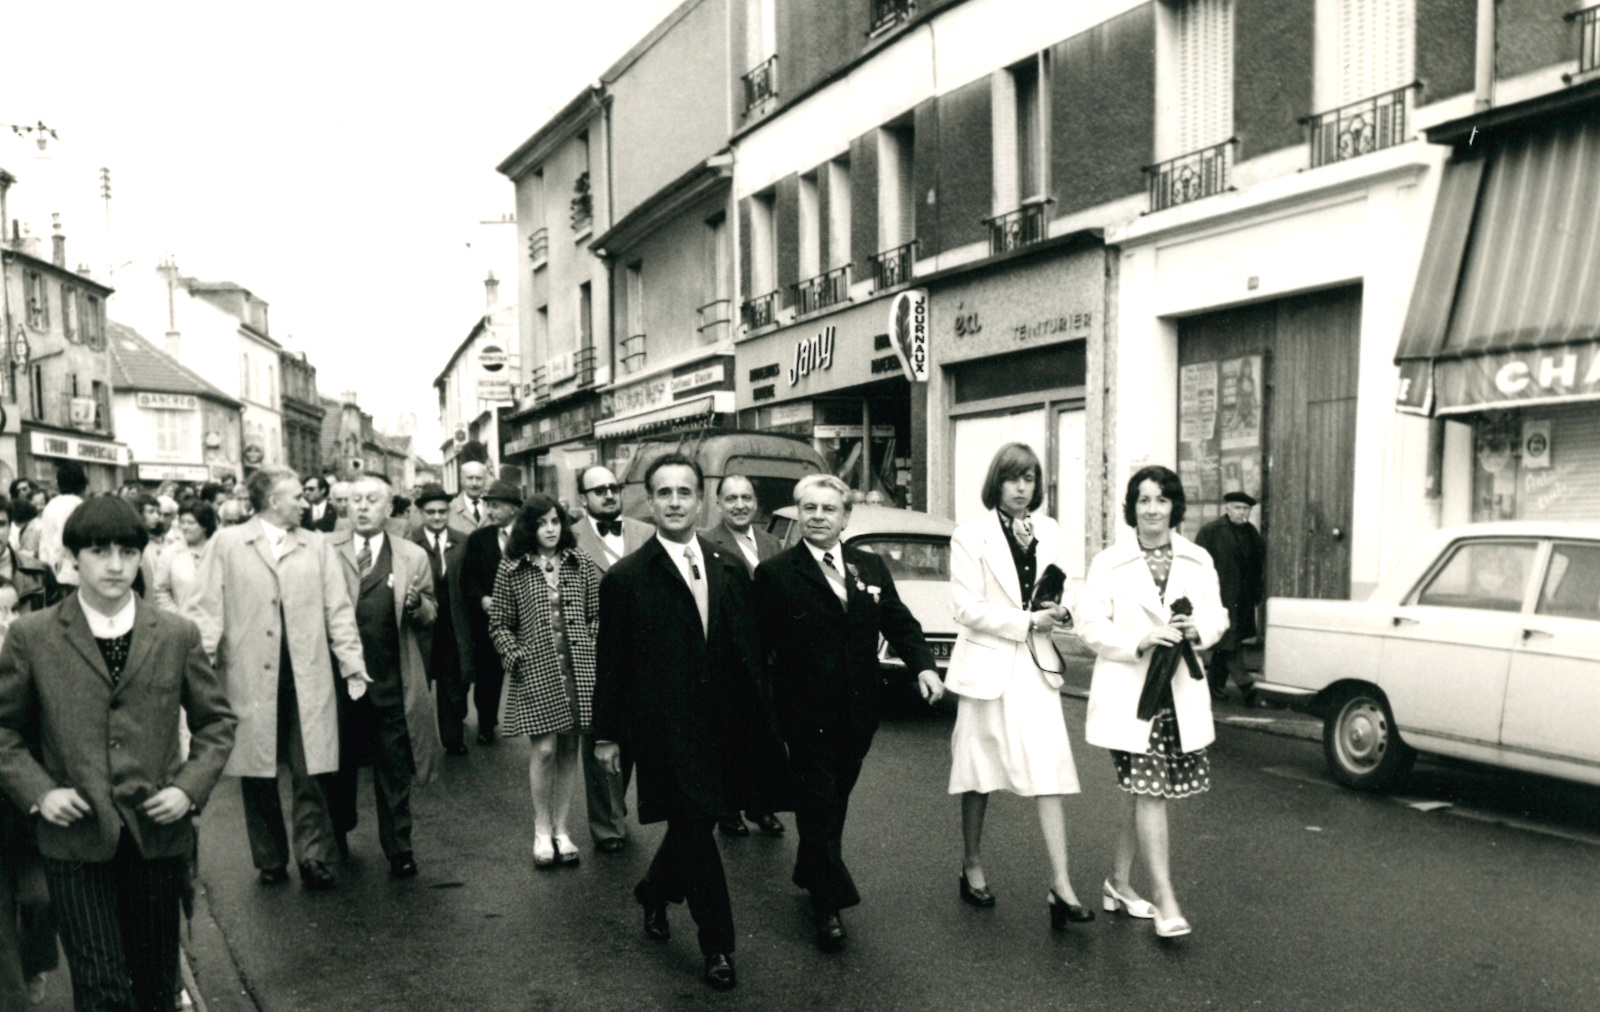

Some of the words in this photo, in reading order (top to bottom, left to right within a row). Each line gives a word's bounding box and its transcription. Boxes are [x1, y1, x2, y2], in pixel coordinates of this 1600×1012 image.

[787, 325, 836, 388] Jany
[914, 296, 926, 373] JOURNAUX
[1013, 313, 1092, 341] TEINTURIER
